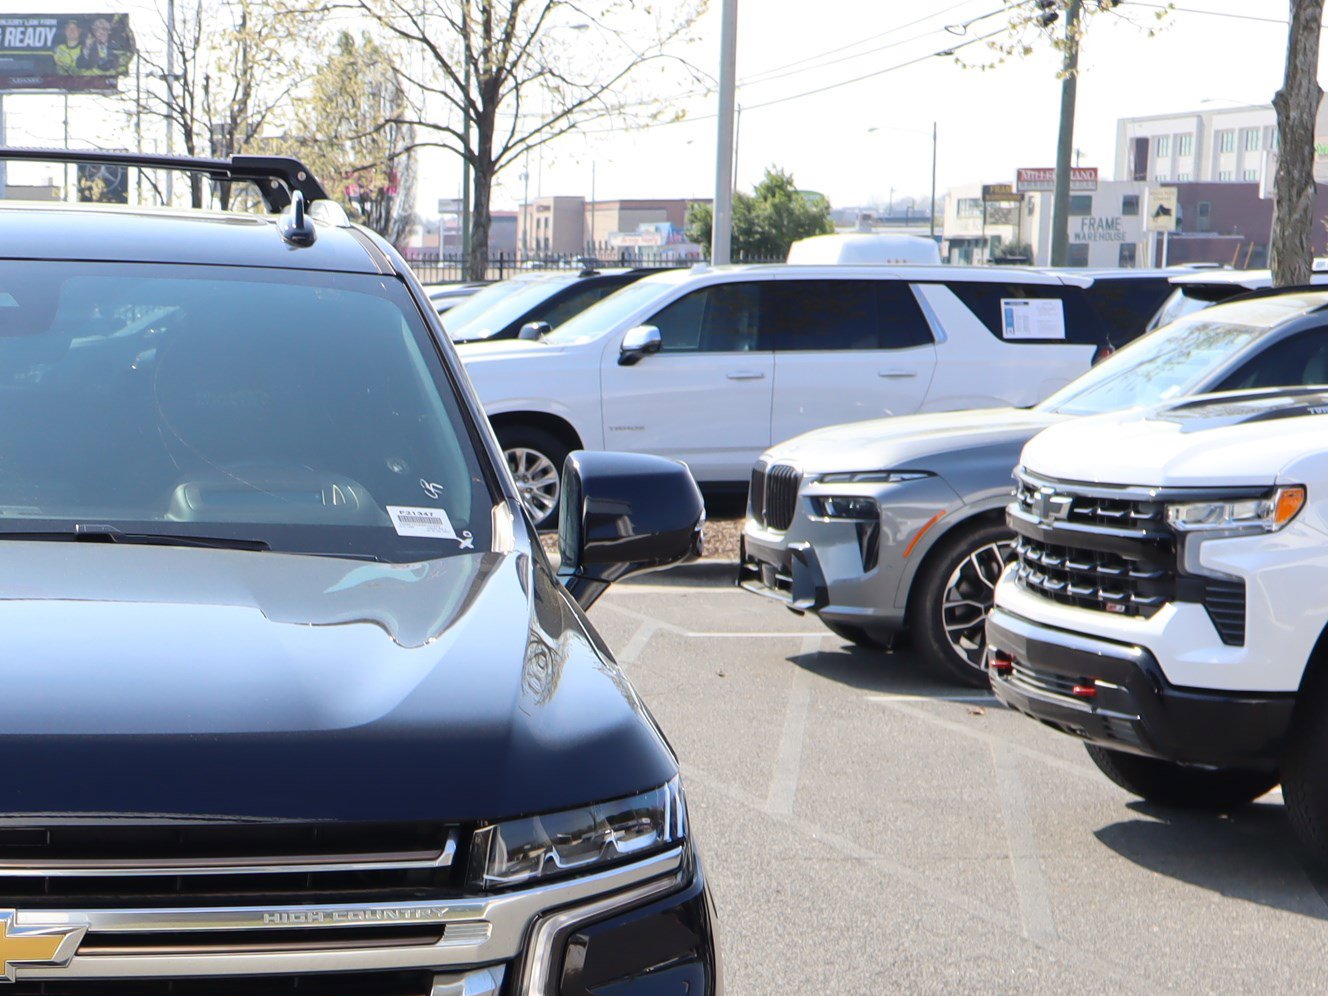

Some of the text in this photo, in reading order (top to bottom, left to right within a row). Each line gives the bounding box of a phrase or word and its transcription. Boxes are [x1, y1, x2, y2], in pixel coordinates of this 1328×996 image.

[4, 26, 56, 47] READY
[1022, 169, 1056, 180] MILLE
[1081, 217, 1122, 231] FRAME
[1074, 231, 1127, 242] WAREHOUSE
[263, 907, 449, 924] HIGH COUNTRY
